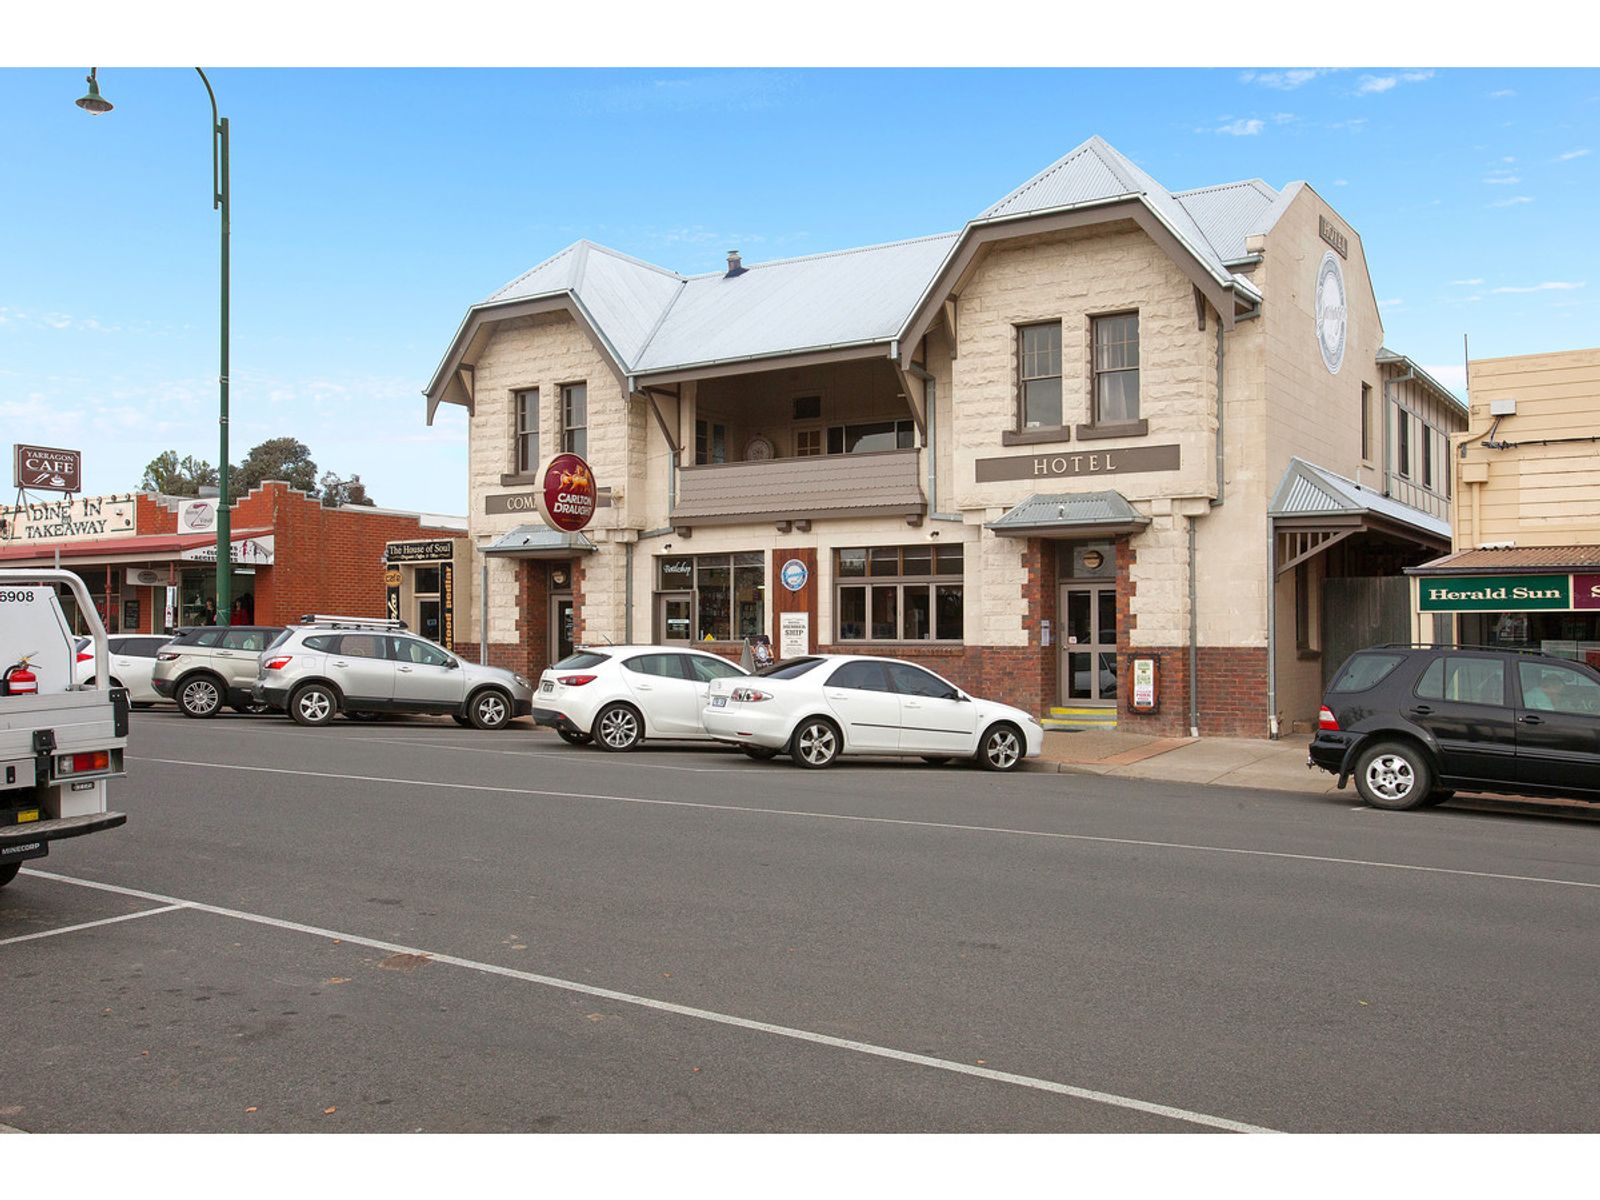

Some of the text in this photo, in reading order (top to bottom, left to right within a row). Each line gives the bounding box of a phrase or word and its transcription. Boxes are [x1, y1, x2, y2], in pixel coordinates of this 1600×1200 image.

[26, 450, 74, 463] YARRAGON
[25, 459, 75, 473] CAFE
[1034, 454, 1117, 475] HOTEL
[506, 497, 536, 511] COM
[557, 492, 592, 506] CARLTON
[33, 506, 71, 521] DINE
[84, 502, 102, 517] IN
[25, 519, 108, 539] TAKEAWAY
[389, 542, 451, 555] The House of Soul
[1428, 587, 1562, 600] Herald Sun
